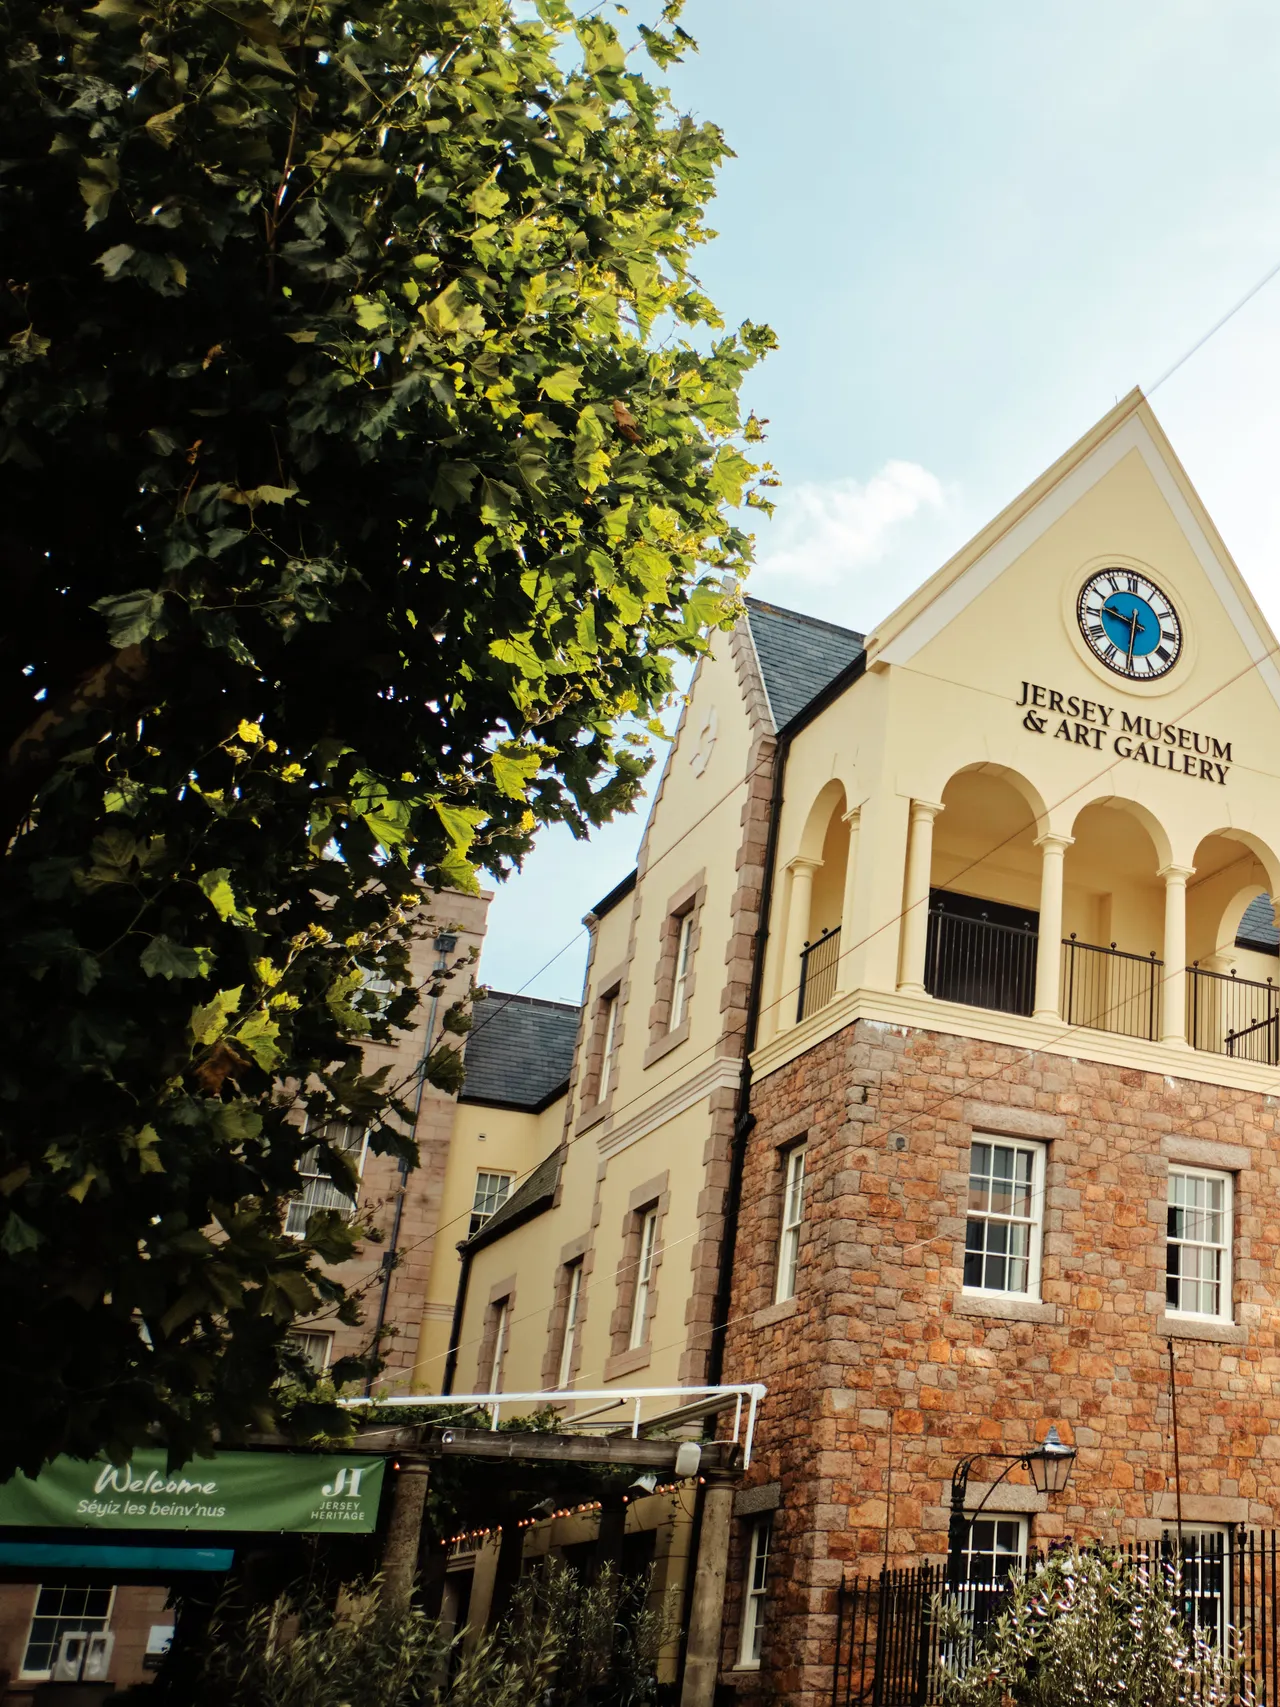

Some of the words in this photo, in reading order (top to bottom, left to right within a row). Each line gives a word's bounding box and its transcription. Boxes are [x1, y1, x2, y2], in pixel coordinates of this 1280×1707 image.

[1016, 681, 1114, 727] JERSEY
[1121, 711, 1233, 762] MUSEUM
[1023, 709, 1048, 734] &
[1054, 719, 1107, 751] ART
[1114, 736, 1231, 786] GALLERY
[94, 1462, 219, 1494] Welcome
[76, 1499, 121, 1517] Séyiz
[124, 1500, 147, 1515] les
[310, 1510, 365, 1520] HERITAGE
[319, 1501, 361, 1511] JERSEY
